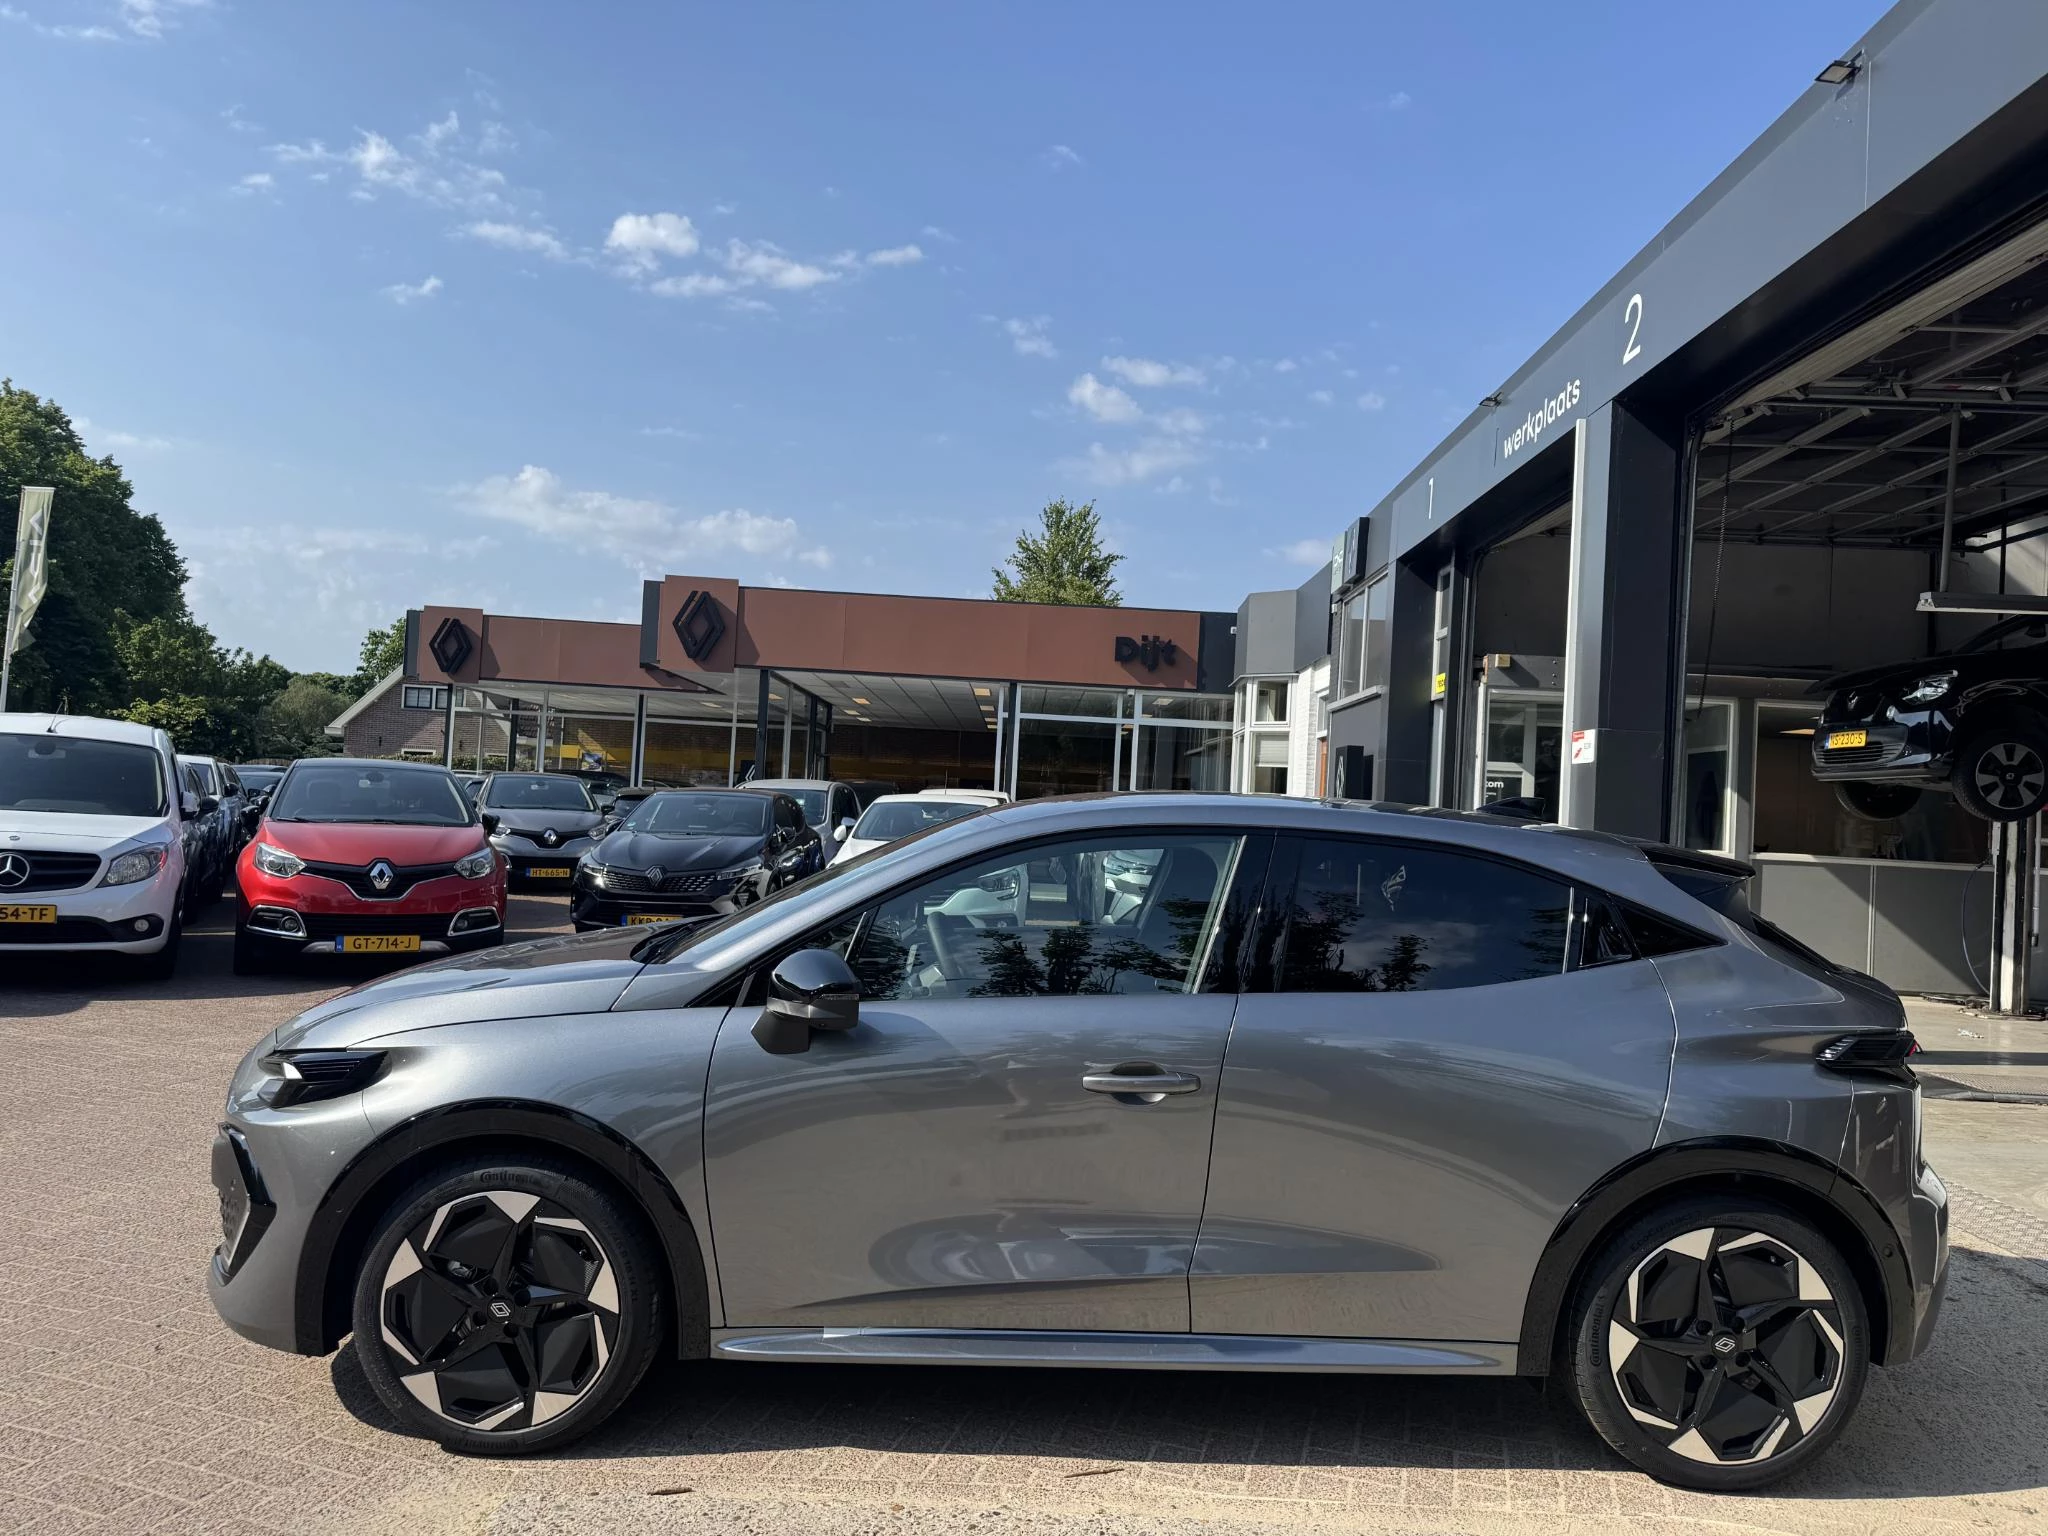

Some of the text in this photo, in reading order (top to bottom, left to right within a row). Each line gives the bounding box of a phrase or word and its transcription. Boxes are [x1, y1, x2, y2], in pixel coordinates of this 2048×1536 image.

[1622, 293, 1643, 366] 2
[1503, 379, 1581, 459] werkplaats
[1428, 476, 1434, 520] 1
[0, 906, 49, 921] 54-TF
[353, 937, 412, 950] GT-714-J
